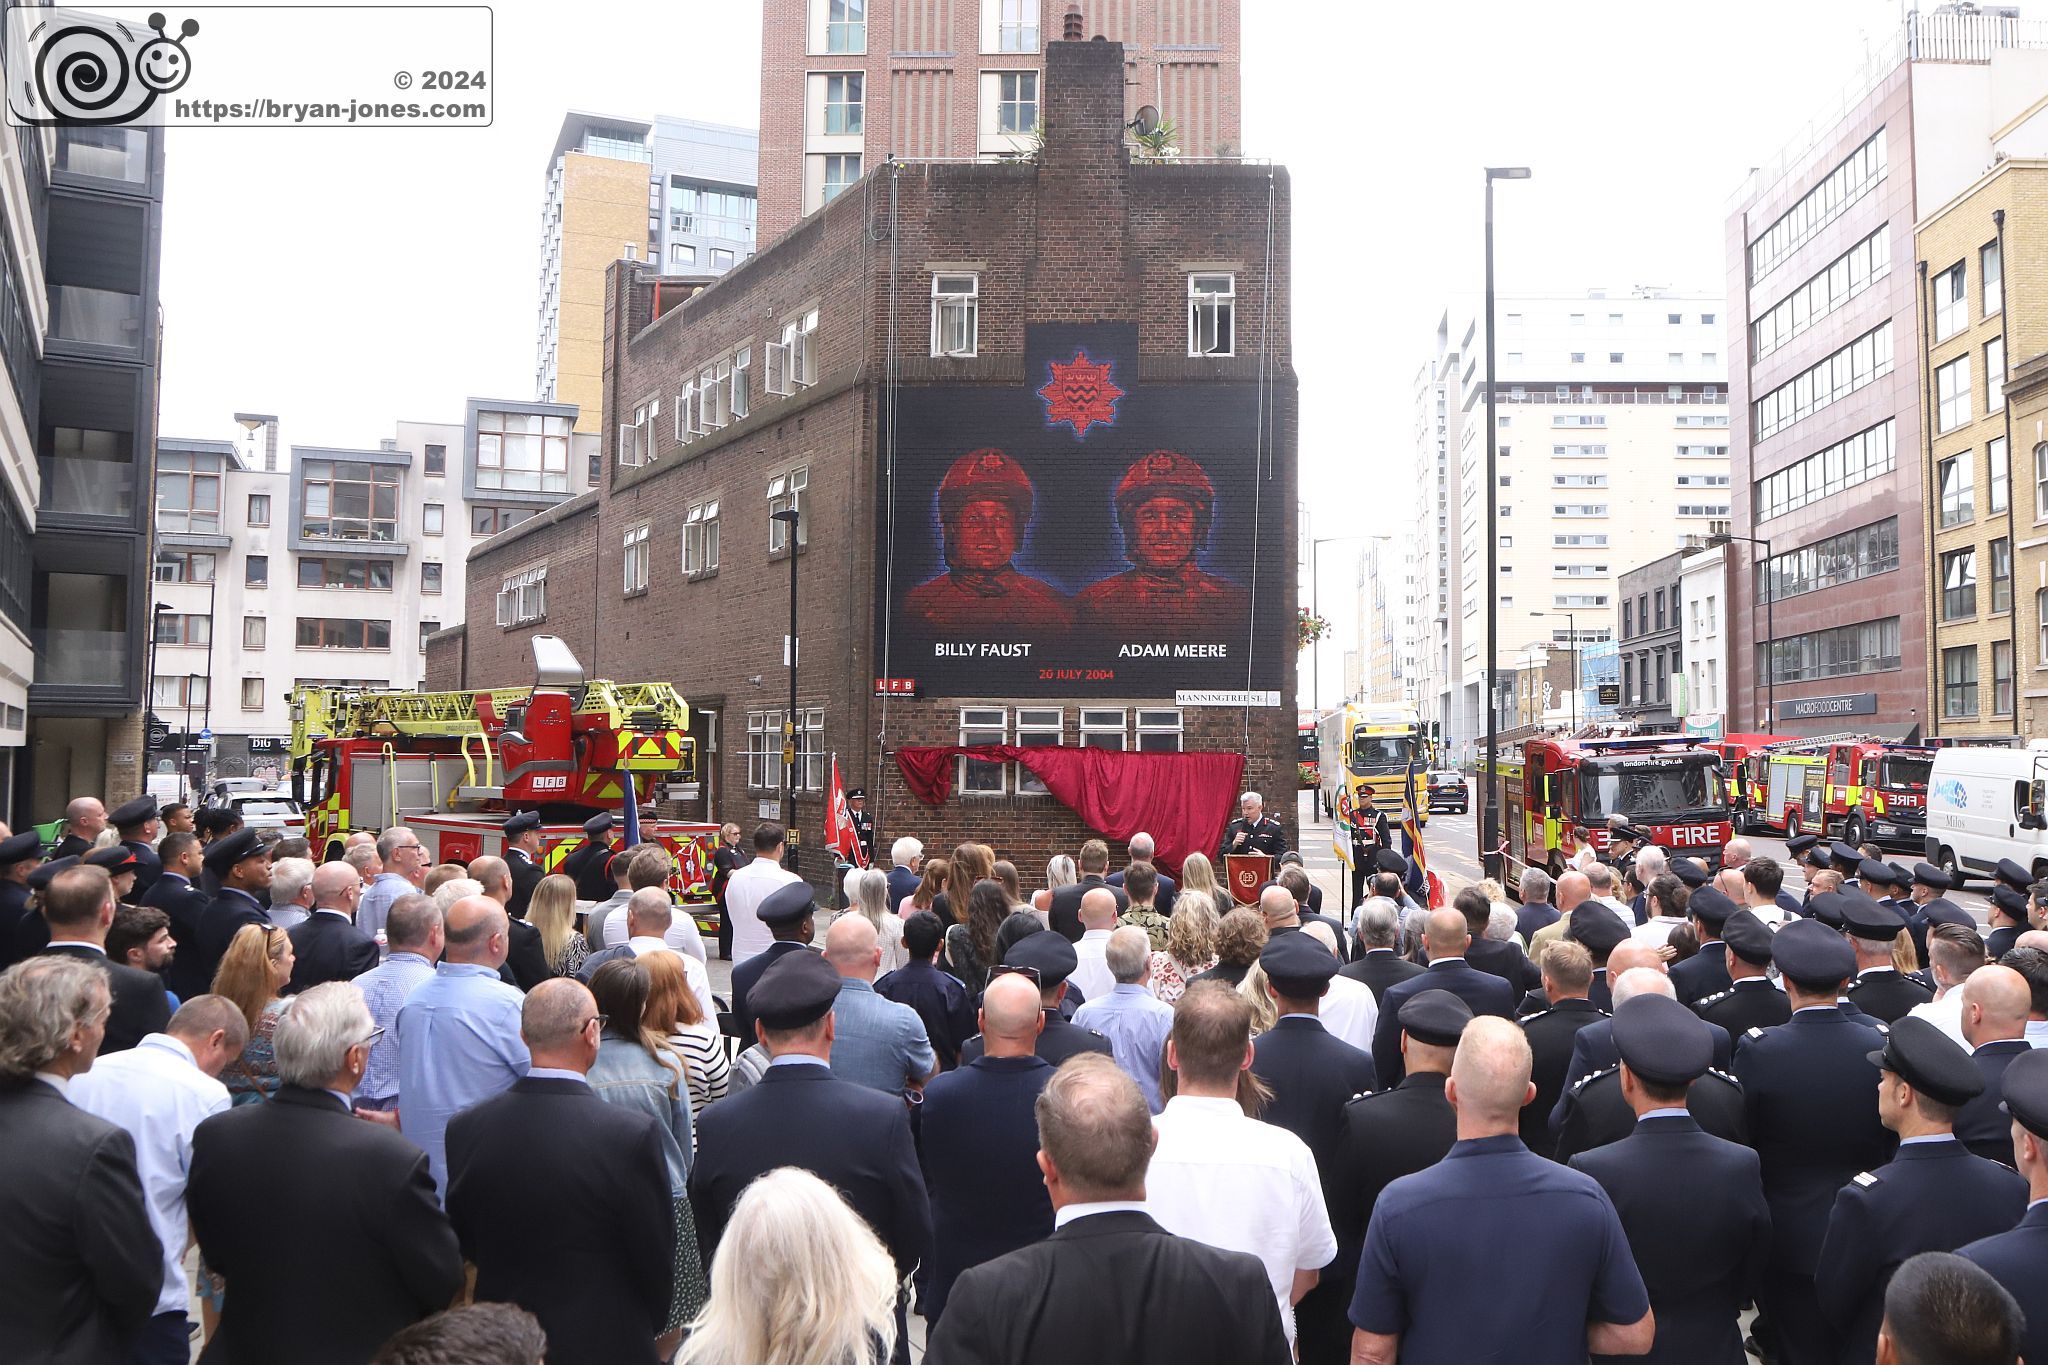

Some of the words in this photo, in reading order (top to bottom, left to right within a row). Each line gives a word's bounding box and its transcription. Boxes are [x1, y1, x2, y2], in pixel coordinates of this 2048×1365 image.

[935, 643, 977, 657] BILLY
[980, 643, 1032, 657] FAUST
[1118, 644, 1170, 657] ADAM
[1173, 644, 1227, 657] MEERE
[1039, 669, 1053, 679] 20
[1056, 669, 1082, 680] JULY
[1085, 669, 1114, 680] 2004
[1177, 694, 1249, 702] MANNINGTREE
[1795, 699, 1853, 715] MACROFOODCENTRE
[1623, 758, 1683, 767] london-fire.gov.uk
[1671, 825, 1721, 846] FIRE
